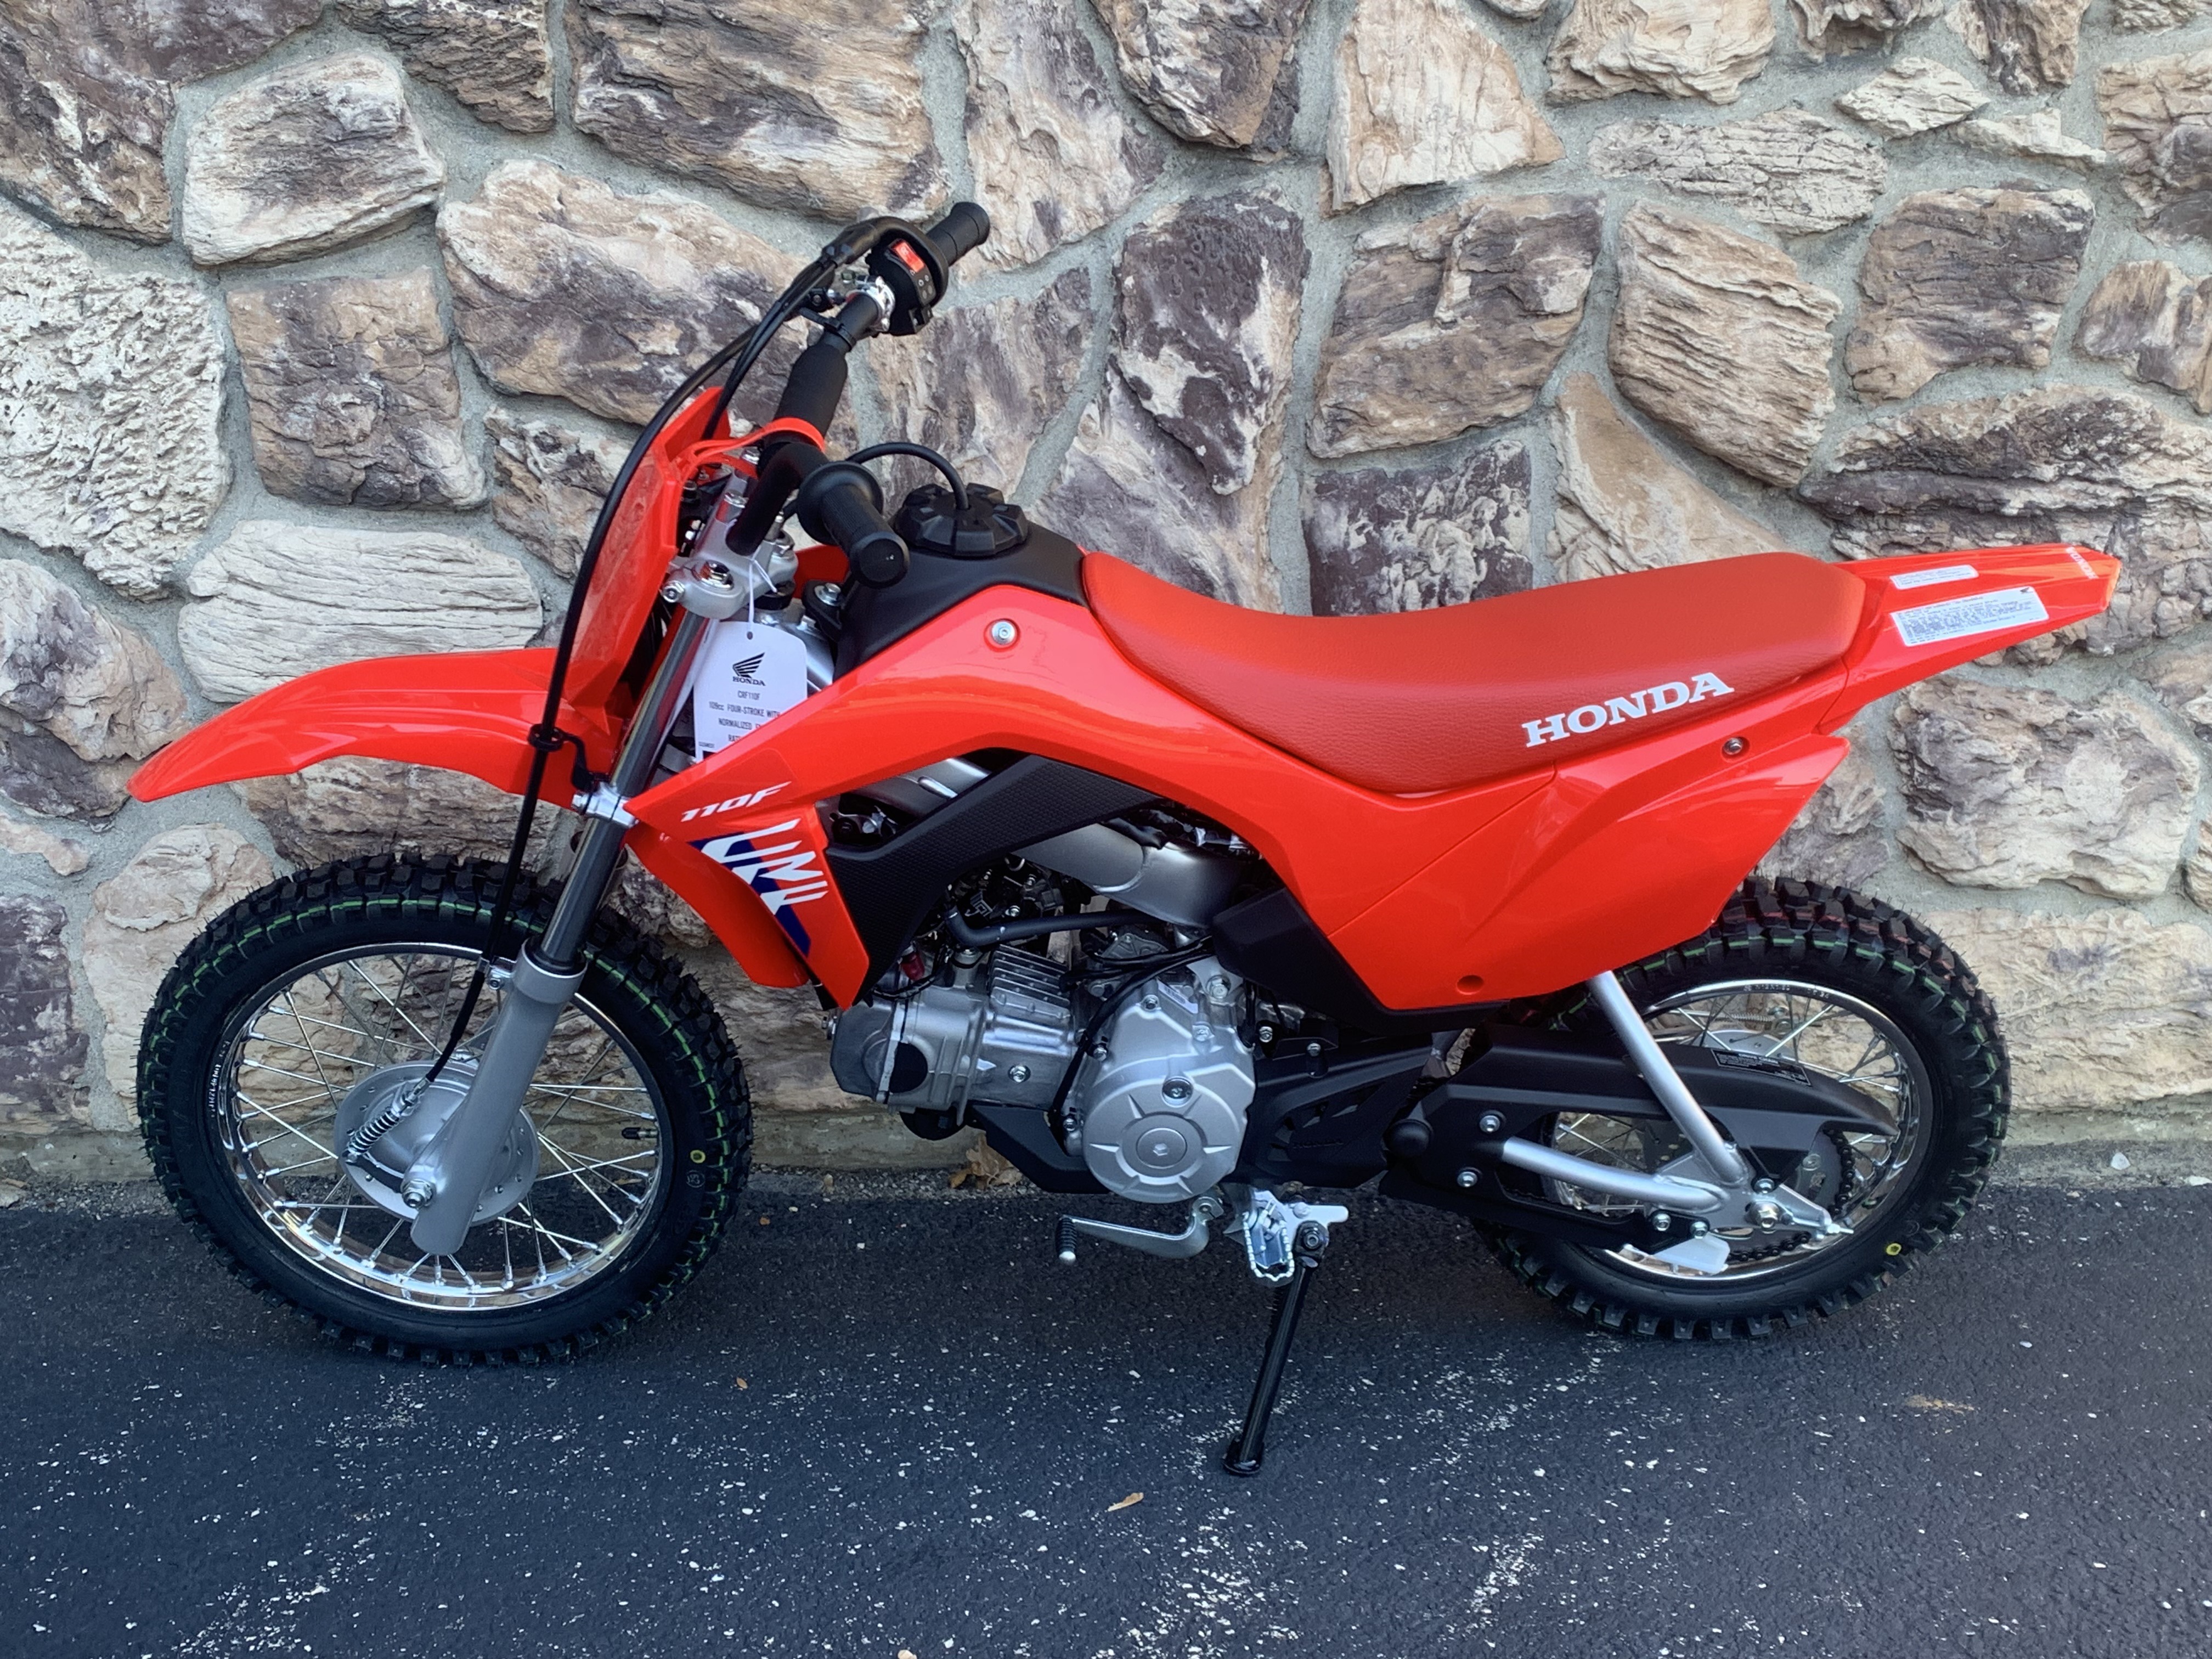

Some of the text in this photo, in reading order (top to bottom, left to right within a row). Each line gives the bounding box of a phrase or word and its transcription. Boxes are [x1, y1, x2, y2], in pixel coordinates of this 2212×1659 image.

[732, 676, 766, 686] HONDA
[737, 690, 760, 701] CRF110F
[727, 704, 764, 717] FOUR-STROKE
[1522, 672, 1735, 748] HONDA
[718, 718, 752, 730] NORMALIZED
[680, 781, 792, 822] 110F
